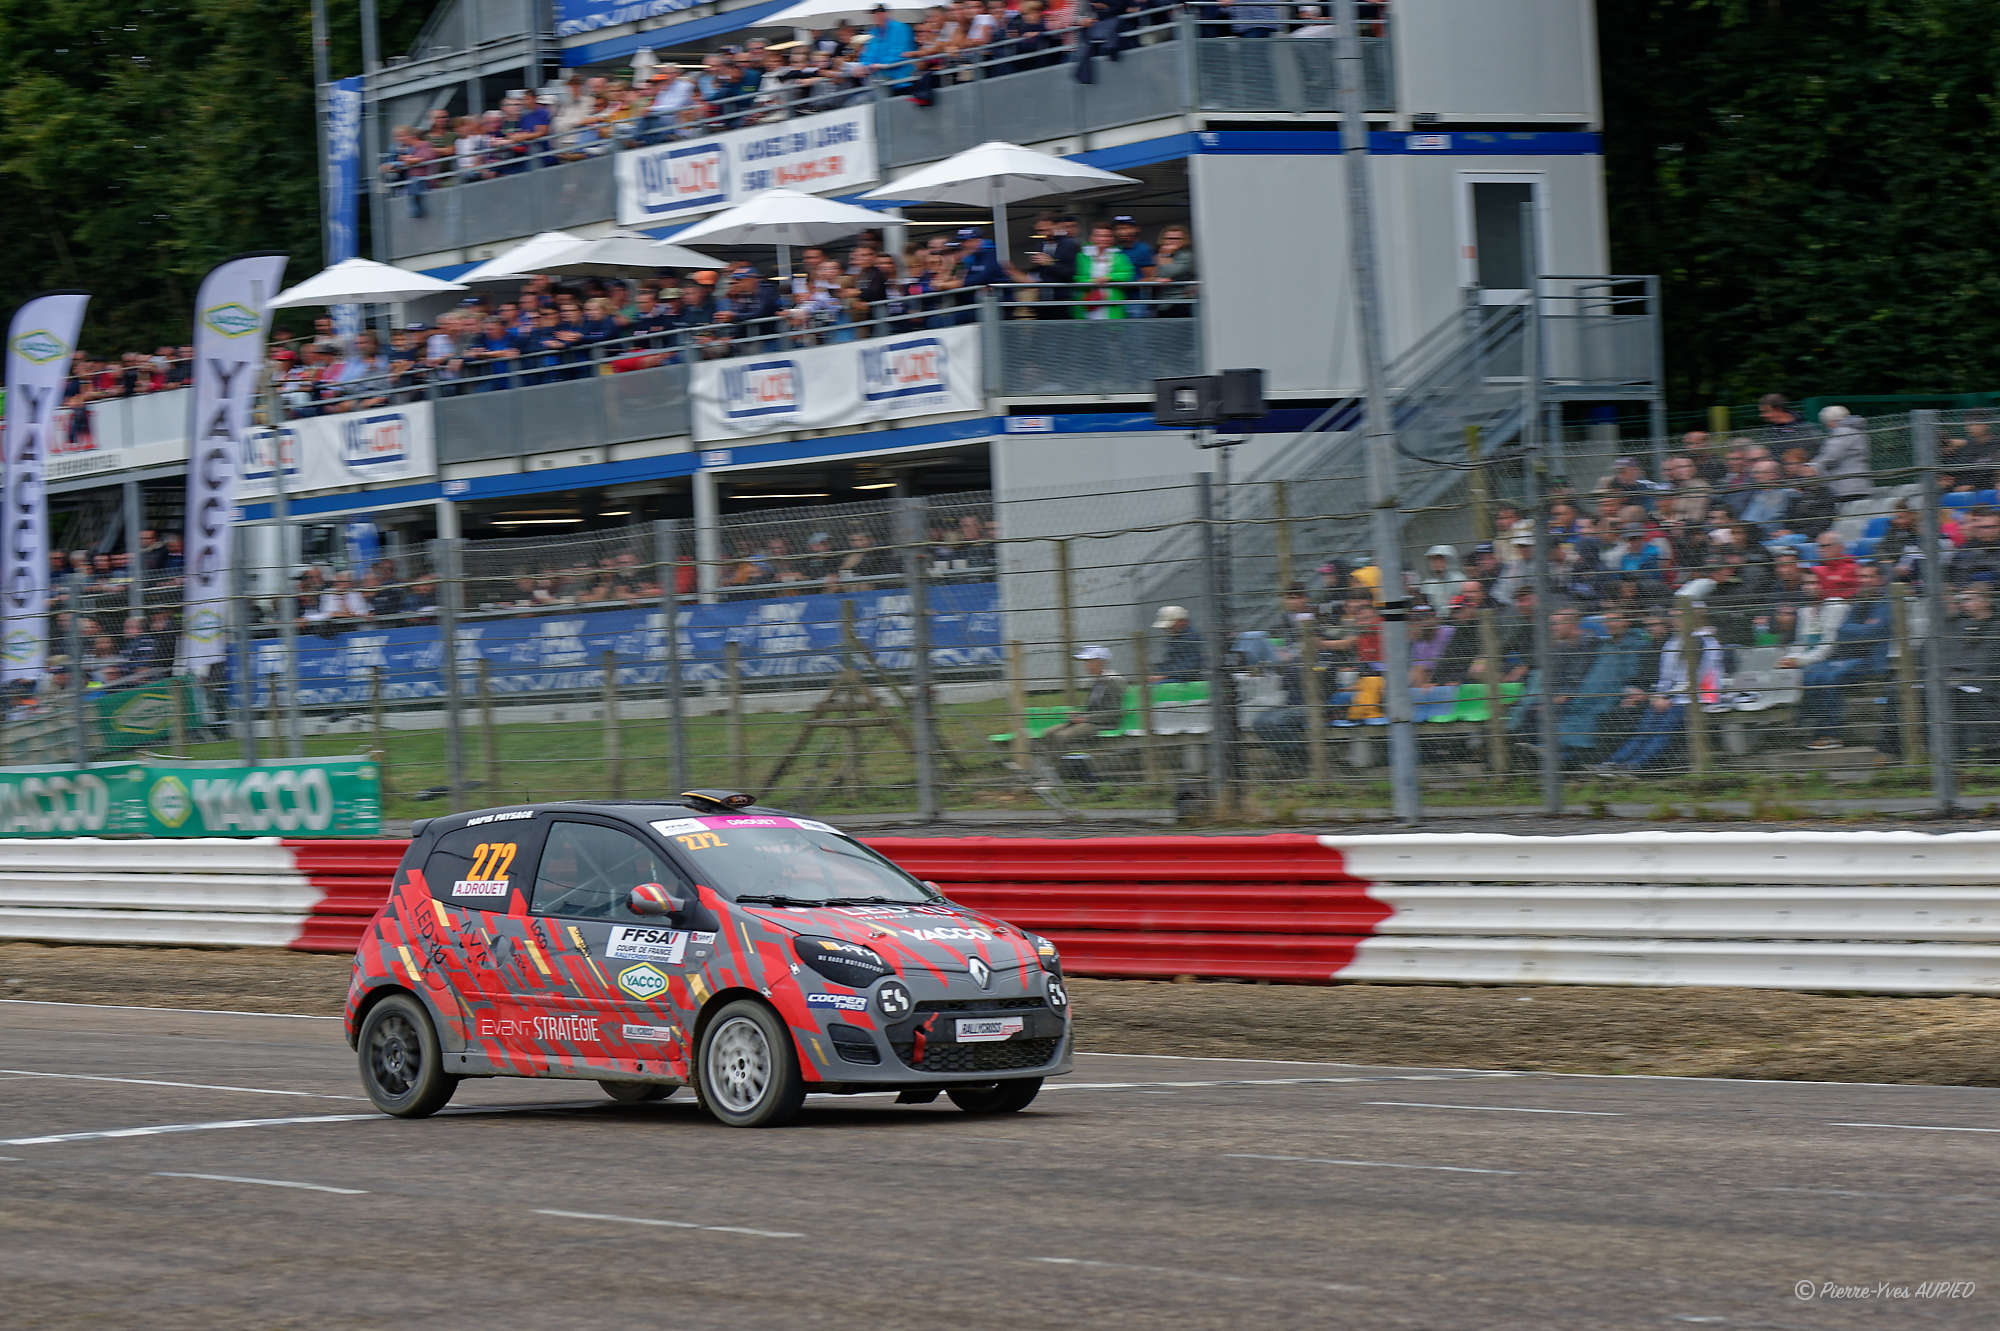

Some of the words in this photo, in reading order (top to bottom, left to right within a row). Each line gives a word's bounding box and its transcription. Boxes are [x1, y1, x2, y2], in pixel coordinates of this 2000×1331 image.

[196, 357, 250, 590] YACCO
[11, 383, 53, 610] YACCO
[191, 768, 333, 831] YACCO
[725, 817, 777, 826] DROUET
[676, 831, 729, 851] 272
[466, 842, 518, 881] 272
[455, 883, 506, 895] A.DROUET
[621, 928, 672, 944] FFSA
[901, 926, 993, 941] YACCO
[616, 944, 637, 954] COUPE
[637, 946, 648, 954] DE
[648, 947, 672, 956] FRANCE
[845, 959, 884, 973] MOTORSPORT
[625, 974, 663, 988] YACCO
[807, 994, 867, 1005] COOPER
[834, 1002, 866, 1011] TIRES
[481, 1019, 533, 1036] EVENT
